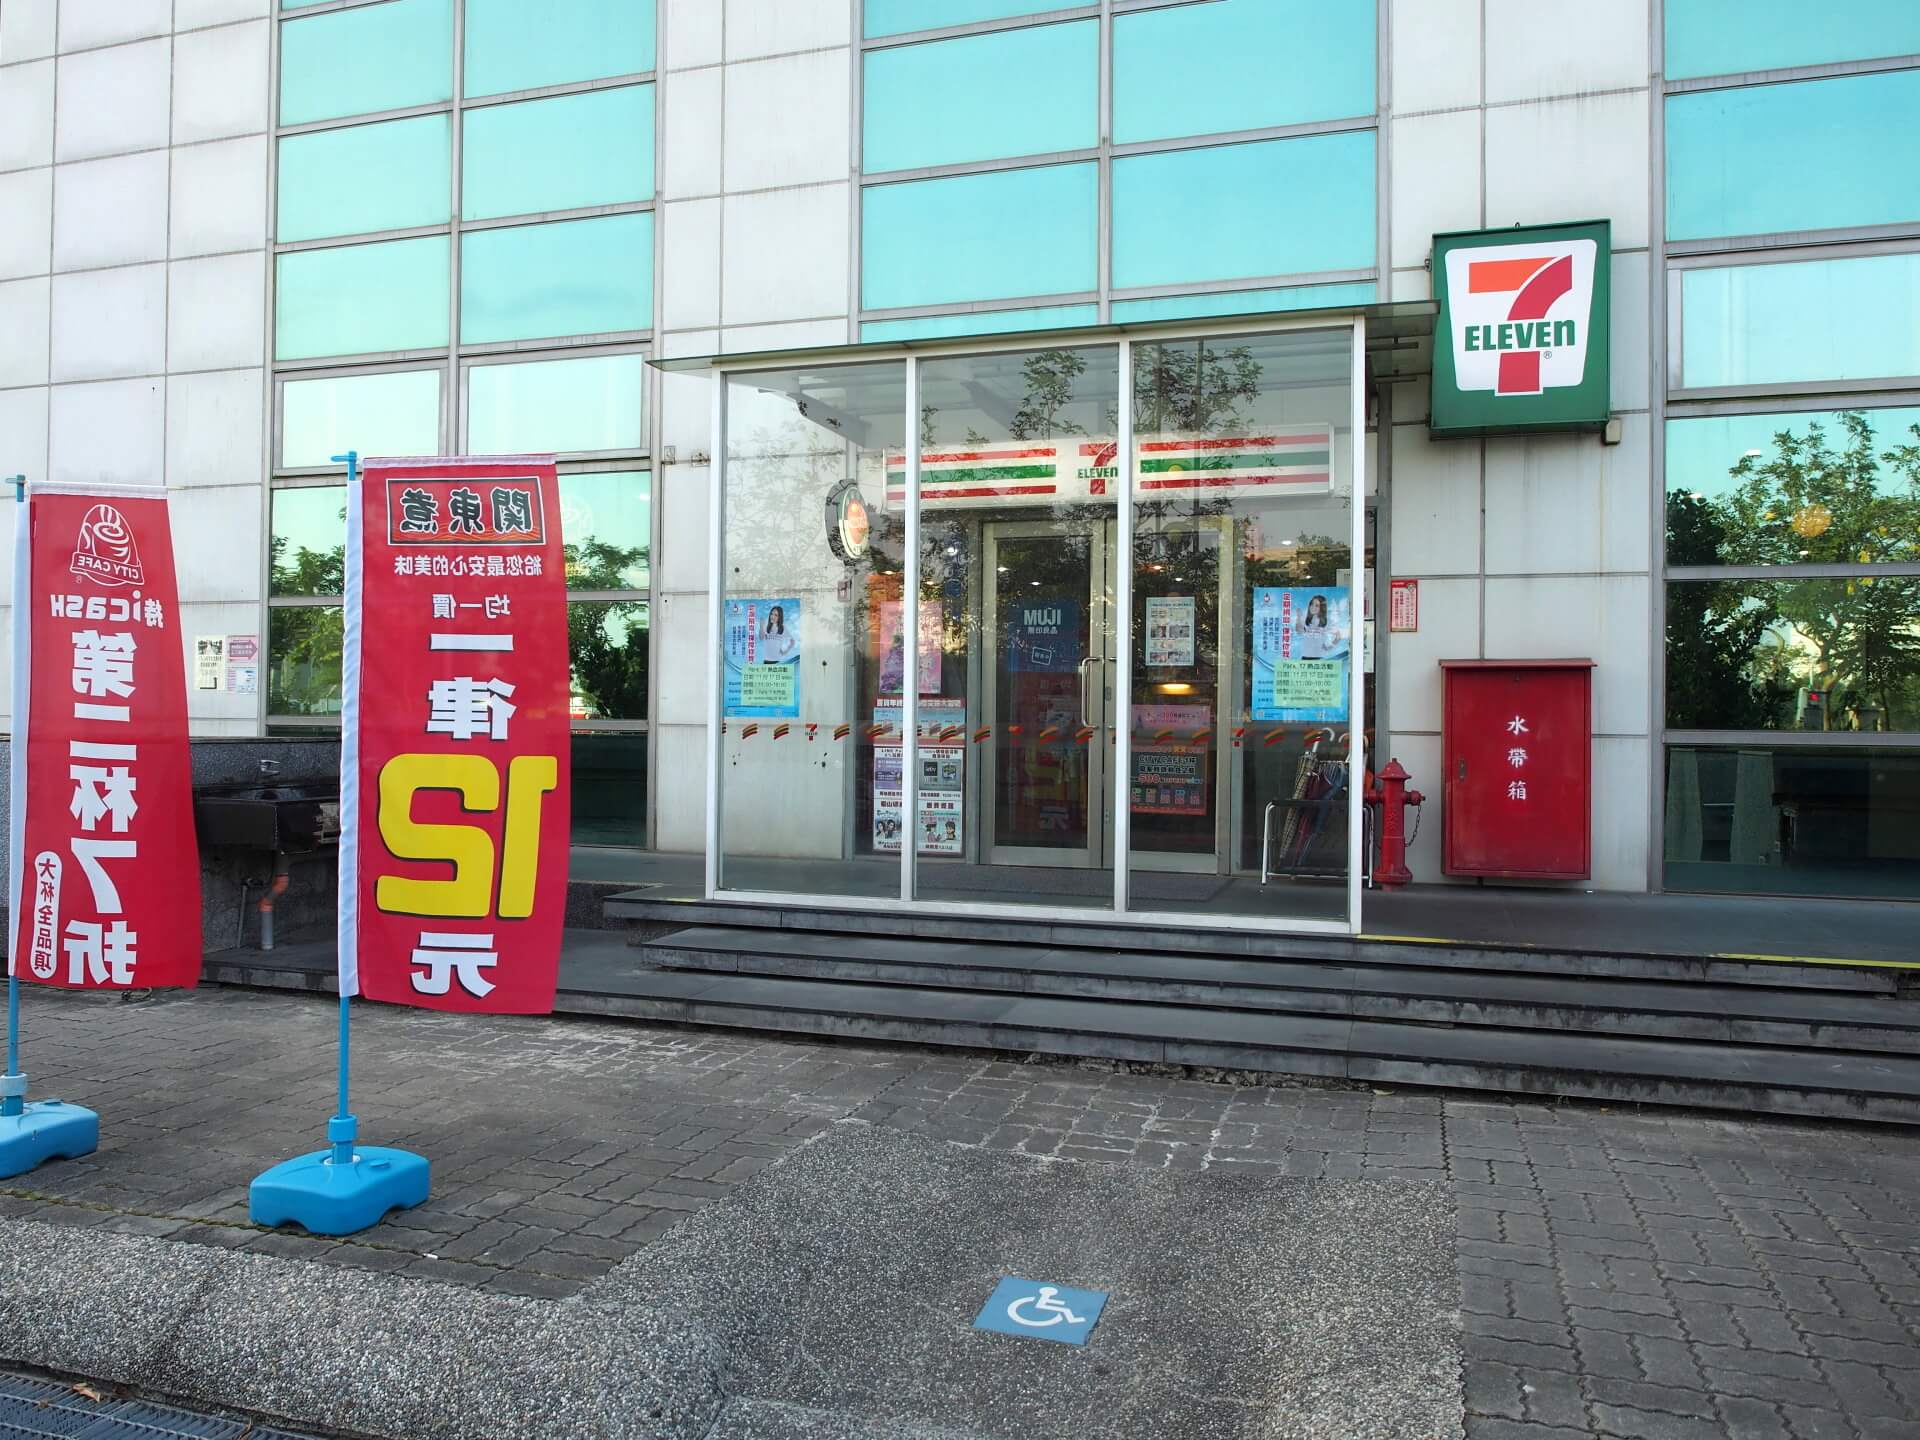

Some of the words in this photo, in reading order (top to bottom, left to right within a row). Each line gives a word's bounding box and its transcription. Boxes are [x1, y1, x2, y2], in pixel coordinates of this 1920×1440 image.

[1468, 254, 1573, 394] 7
[1023, 609, 1062, 626] MUJI
[1507, 715, 1529, 801] 水帶箱
